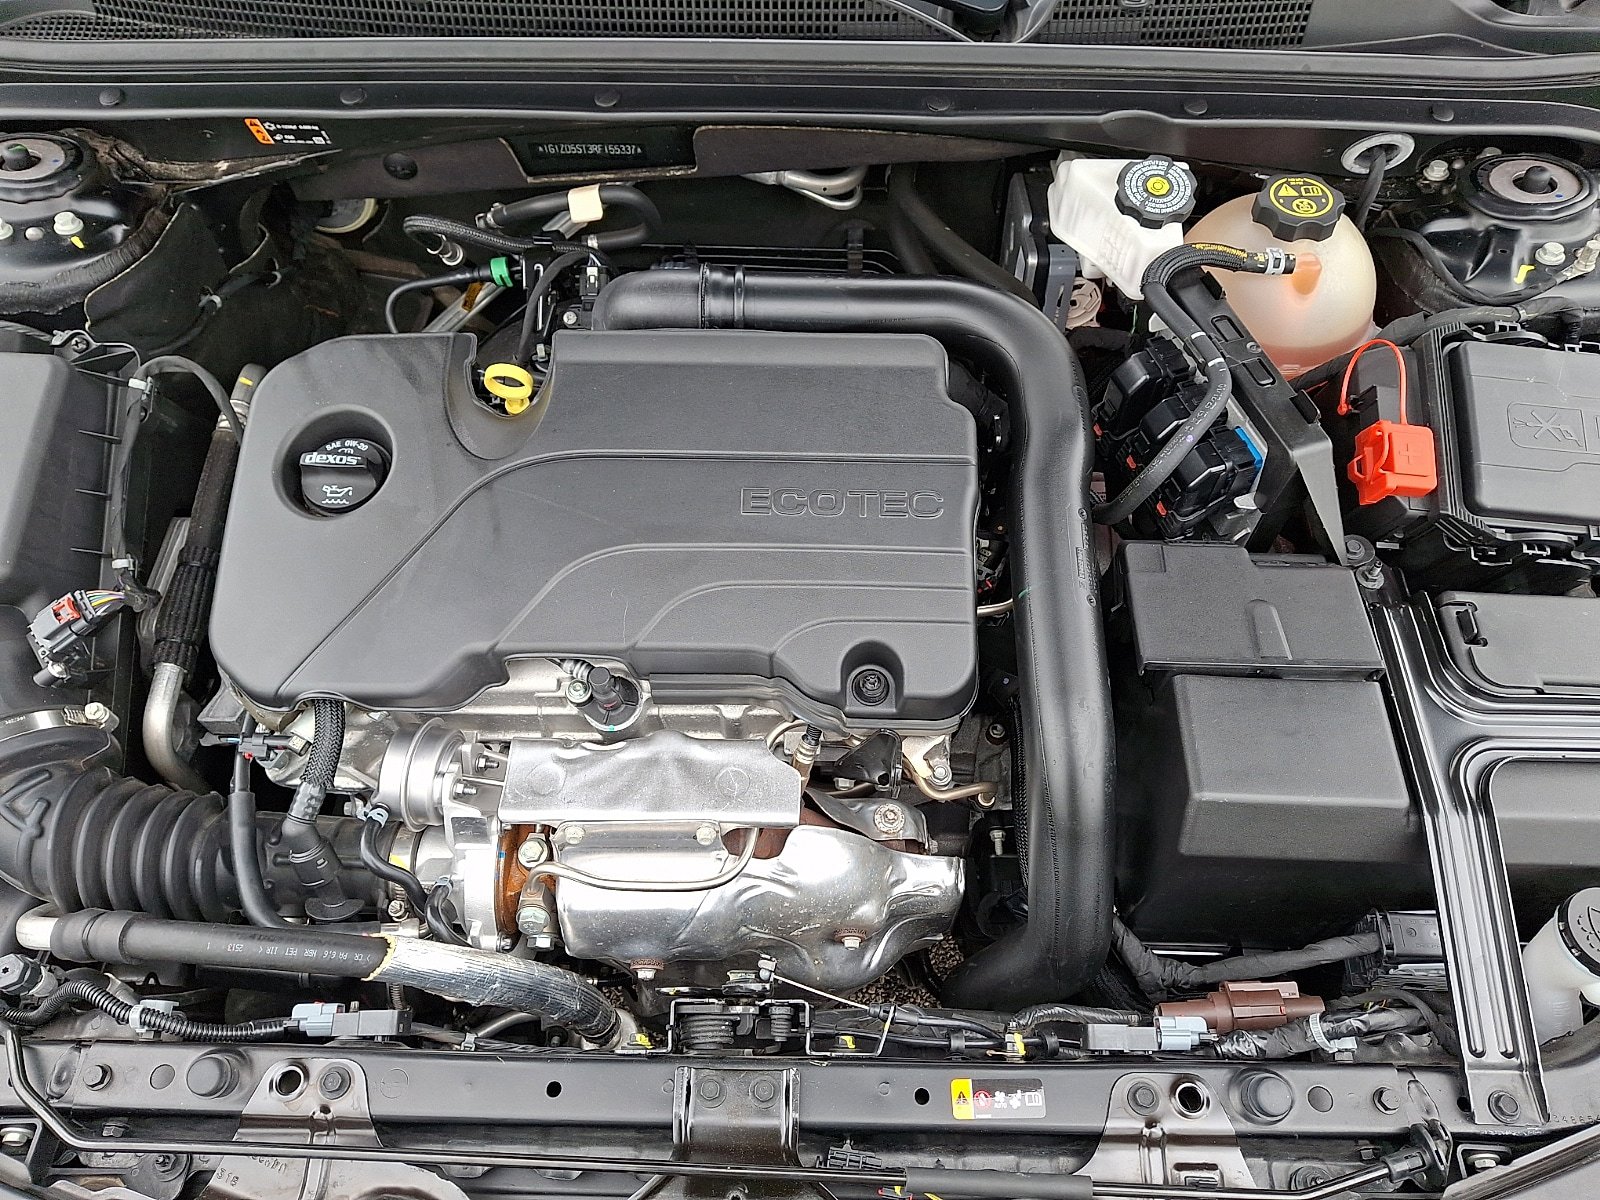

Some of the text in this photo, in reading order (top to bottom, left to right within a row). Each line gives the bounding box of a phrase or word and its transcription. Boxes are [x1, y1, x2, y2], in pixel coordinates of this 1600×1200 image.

[325, 440, 368, 451] SAE 0W-20
[304, 452, 358, 465] dexos
[741, 487, 944, 519] ECOTEC
[284, 947, 298, 956] PET
[338, 952, 349, 960] PA
